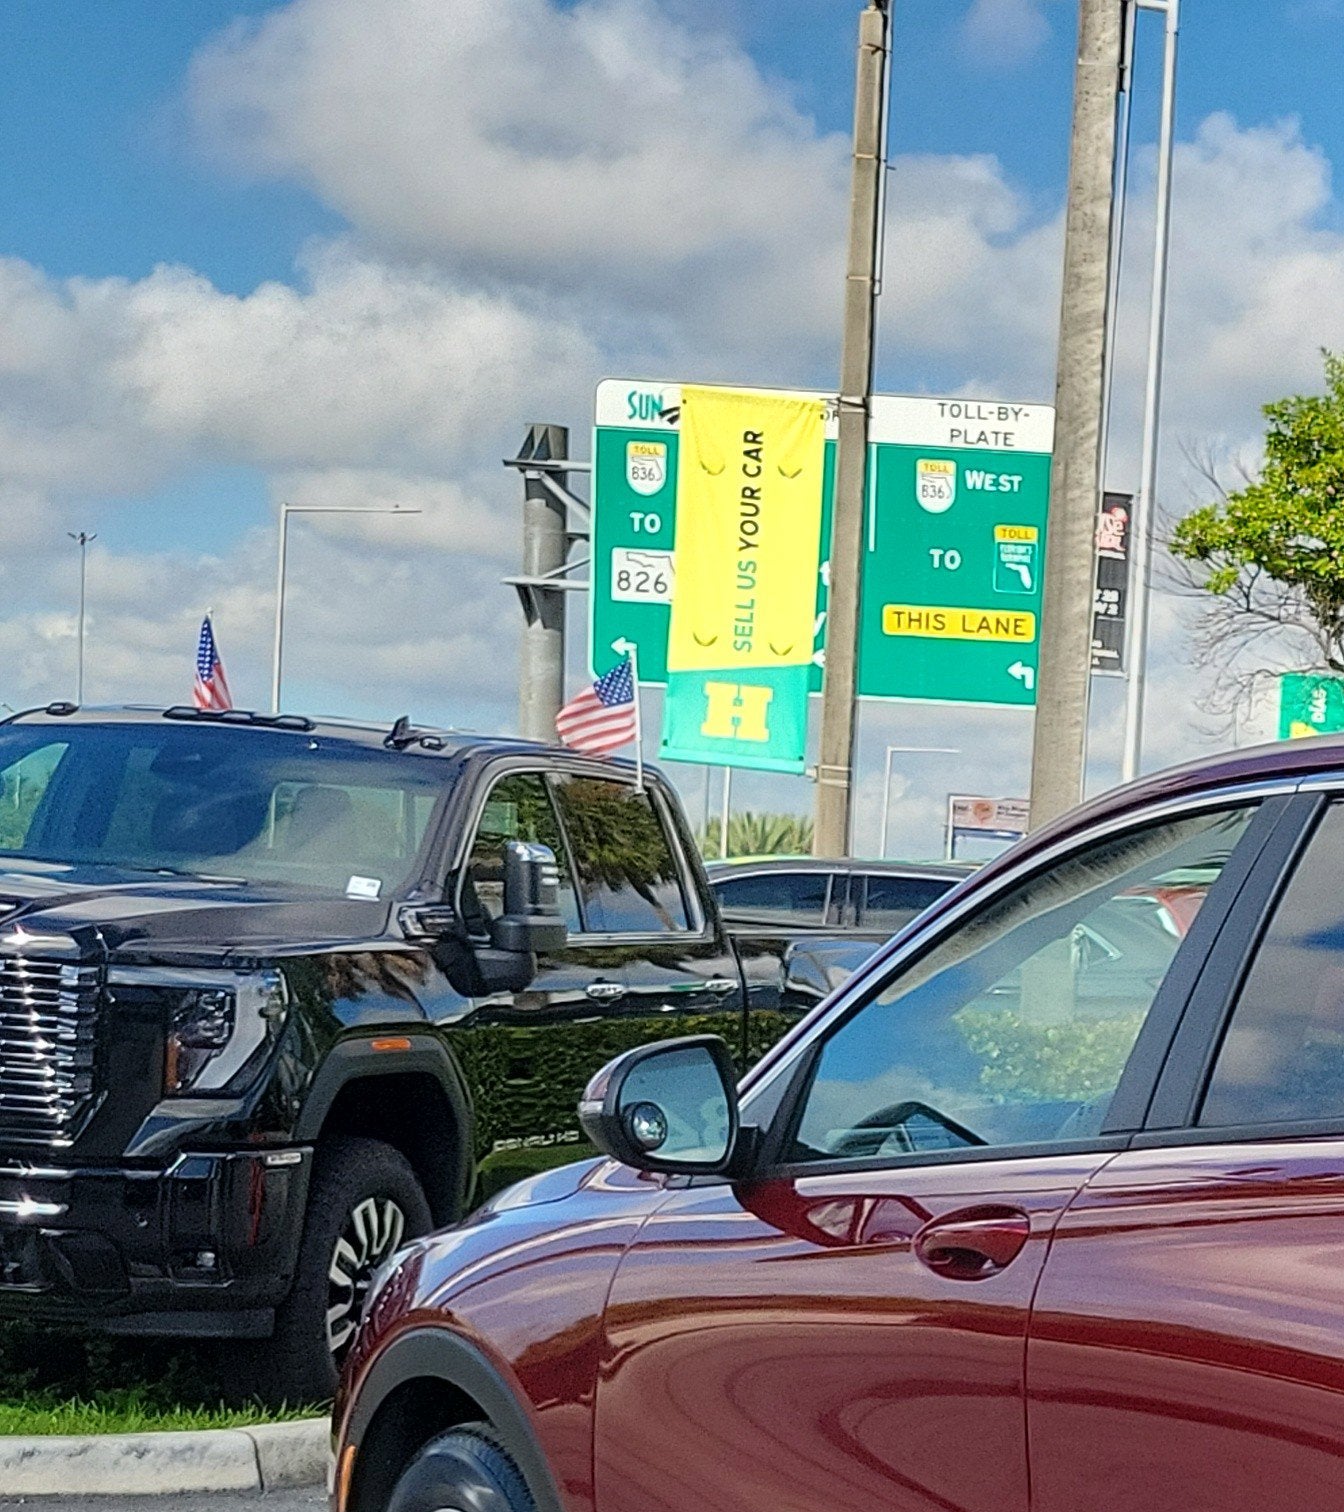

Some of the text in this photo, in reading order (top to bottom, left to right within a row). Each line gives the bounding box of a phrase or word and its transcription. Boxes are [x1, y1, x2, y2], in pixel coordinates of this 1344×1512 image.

[949, 428, 1015, 448] PLATE
[631, 466, 655, 482] 836
[964, 469, 1023, 492] WEST
[921, 484, 944, 500] 836
[629, 511, 662, 534] TO
[732, 430, 764, 653] SELL US YOUR CAR
[1001, 528, 1031, 540] TOLL
[929, 548, 962, 570] TO
[616, 570, 669, 595] 826
[893, 610, 1027, 637] THIS LANE
